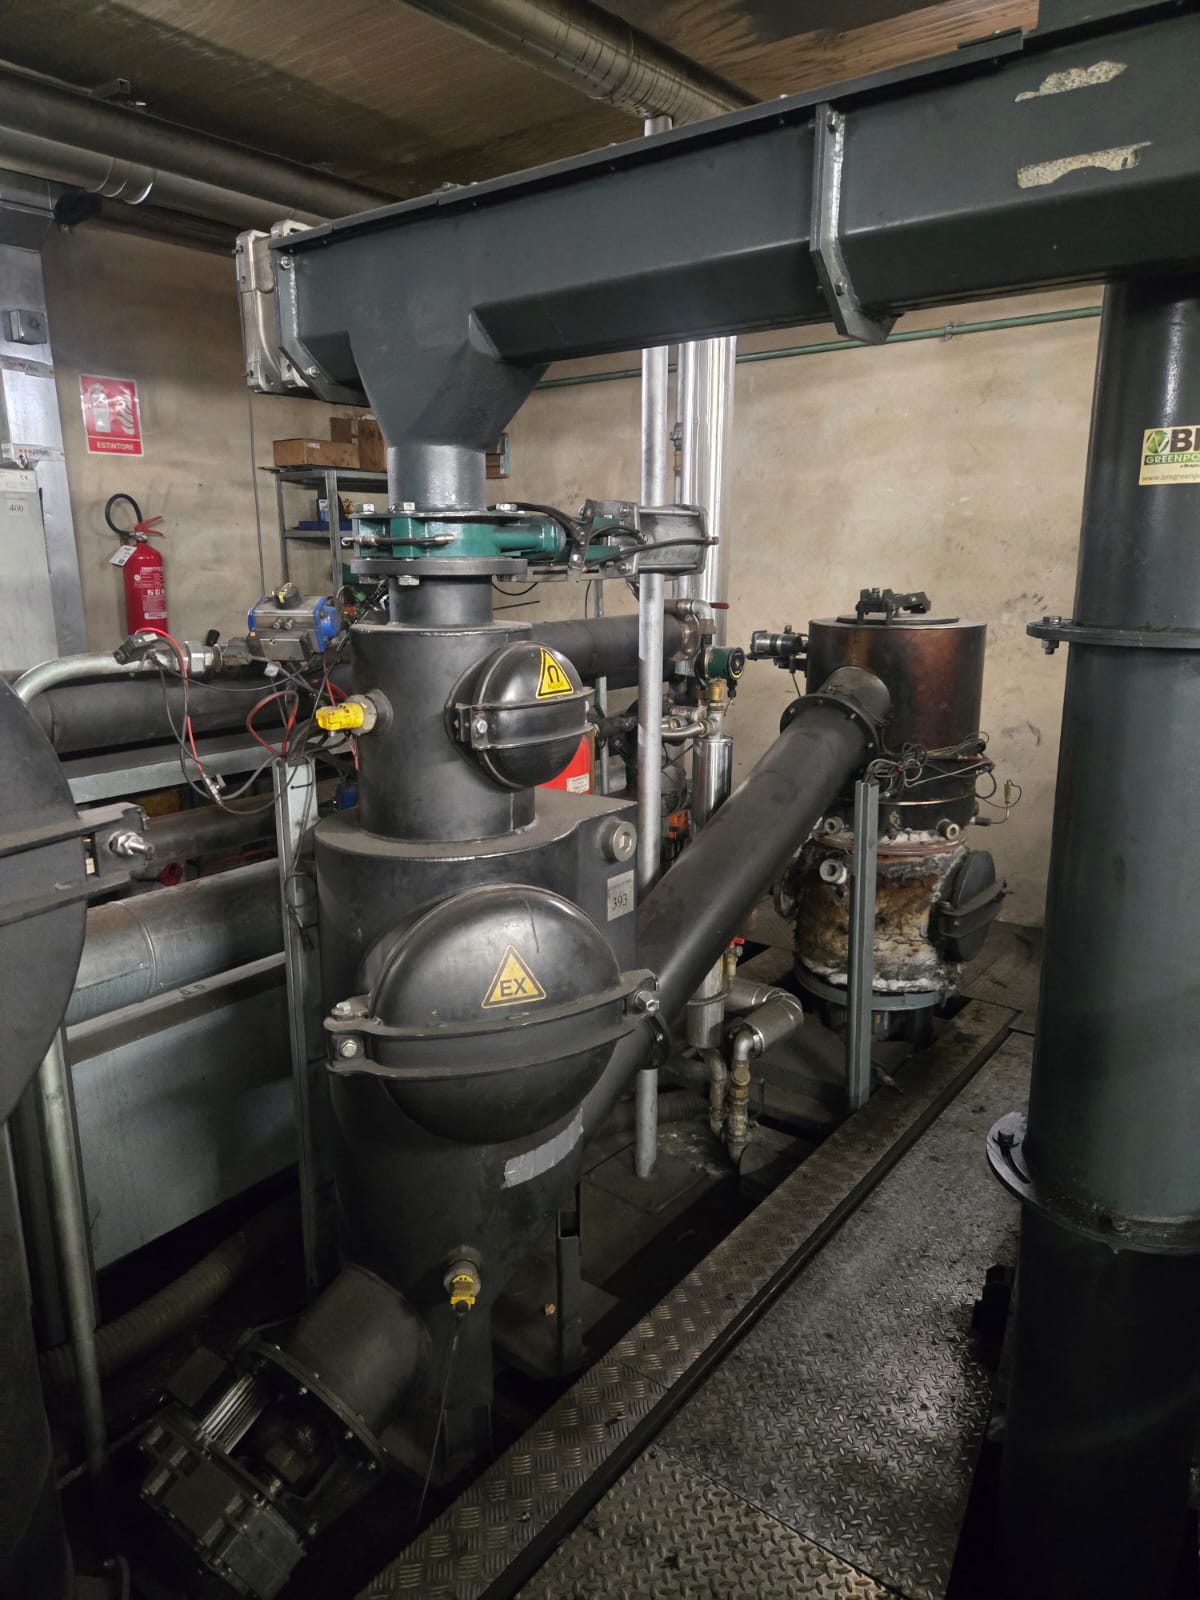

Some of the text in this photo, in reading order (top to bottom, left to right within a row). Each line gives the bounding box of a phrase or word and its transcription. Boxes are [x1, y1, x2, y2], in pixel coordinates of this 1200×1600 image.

[96, 441, 135, 451] ESTINTORE
[9, 504, 24, 512] 400
[612, 892, 628, 911] 393
[500, 976, 528, 997] EX
